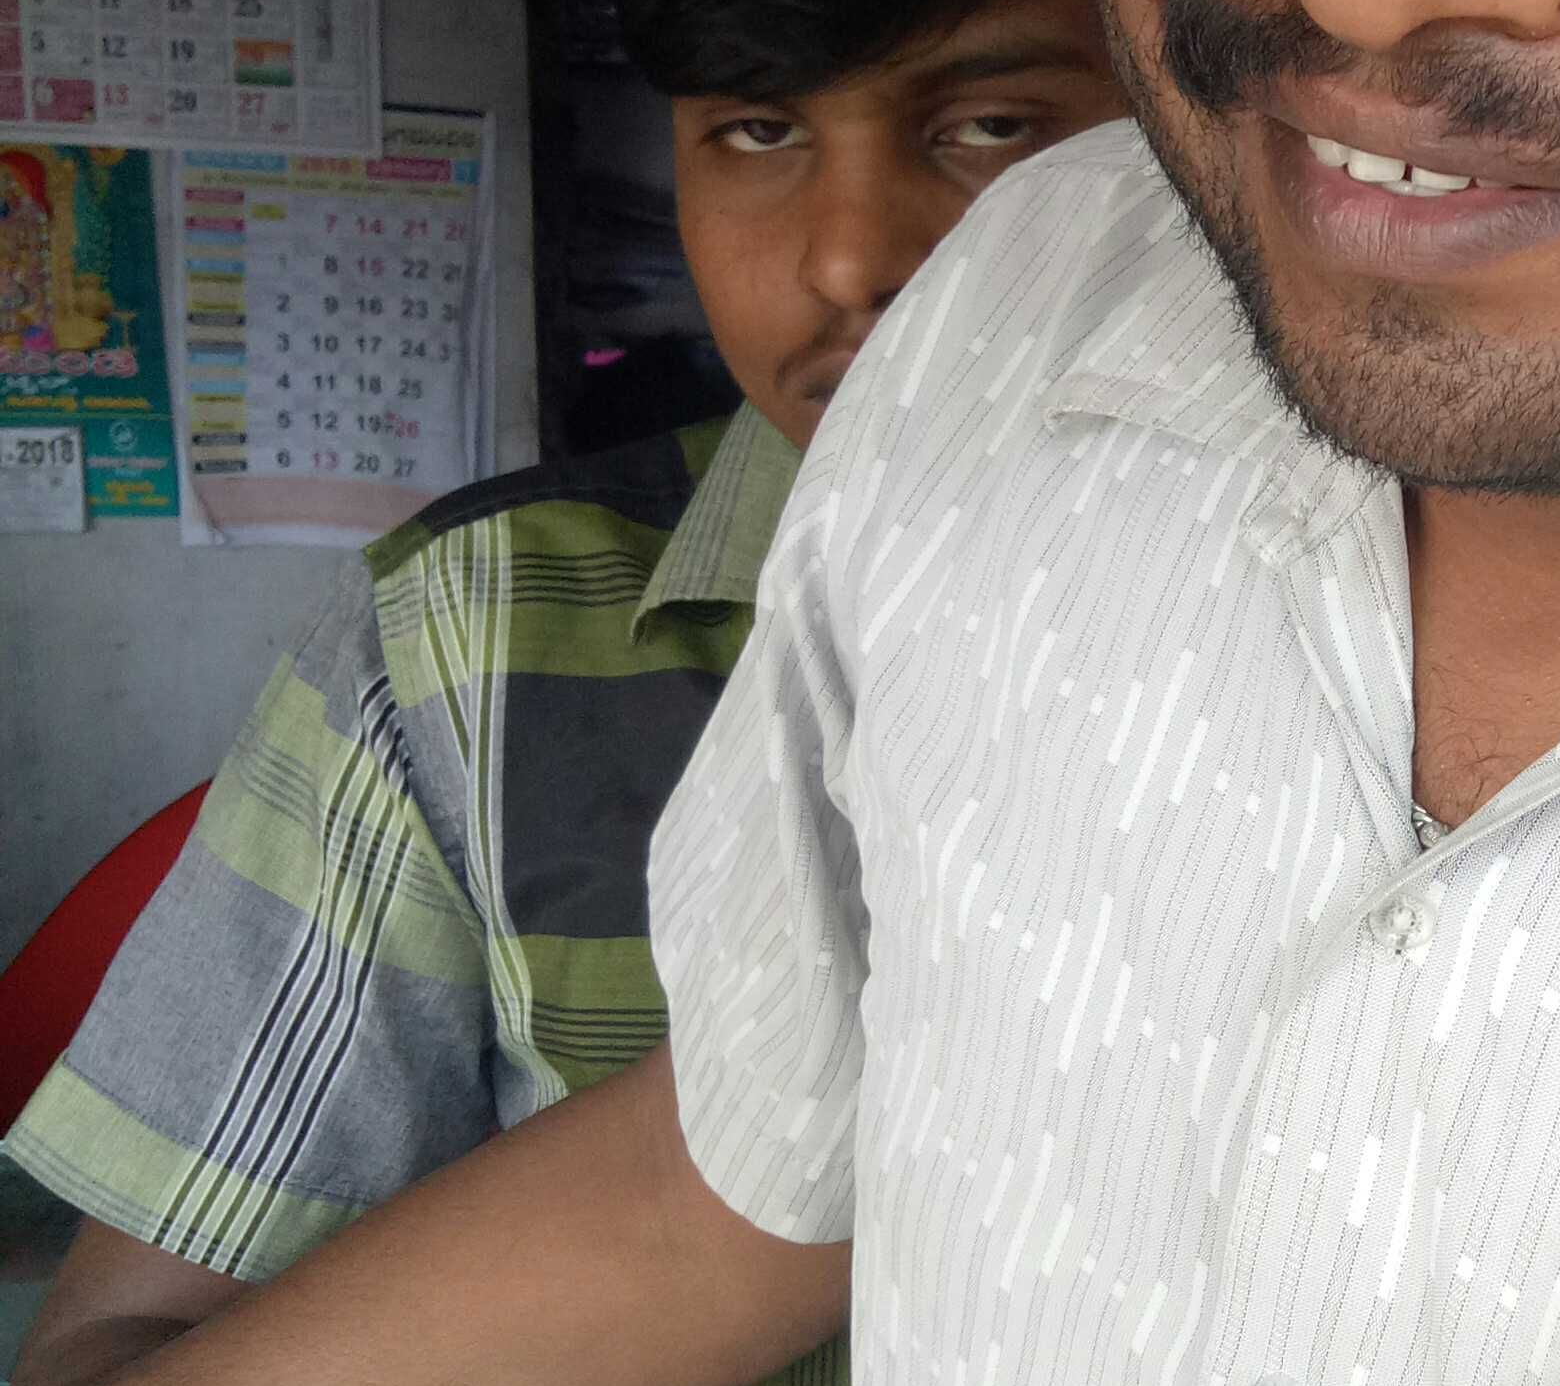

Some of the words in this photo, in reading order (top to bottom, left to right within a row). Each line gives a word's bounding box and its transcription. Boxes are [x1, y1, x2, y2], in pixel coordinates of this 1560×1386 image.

[101, 35, 128, 58] 12
[326, 213, 337, 233] 7
[355, 216, 384, 235] 14
[402, 218, 428, 237] 21
[401, 260, 428, 280] 22
[276, 293, 291, 312] 2
[401, 299, 428, 320] 23
[276, 334, 290, 352] 3
[312, 334, 338, 353] 10
[355, 336, 383, 354] 17
[401, 340, 426, 358] 24
[276, 374, 290, 389] 4
[312, 374, 336, 390] 11
[399, 379, 423, 399] 25
[311, 412, 338, 431] 12
[392, 457, 417, 477] 27
